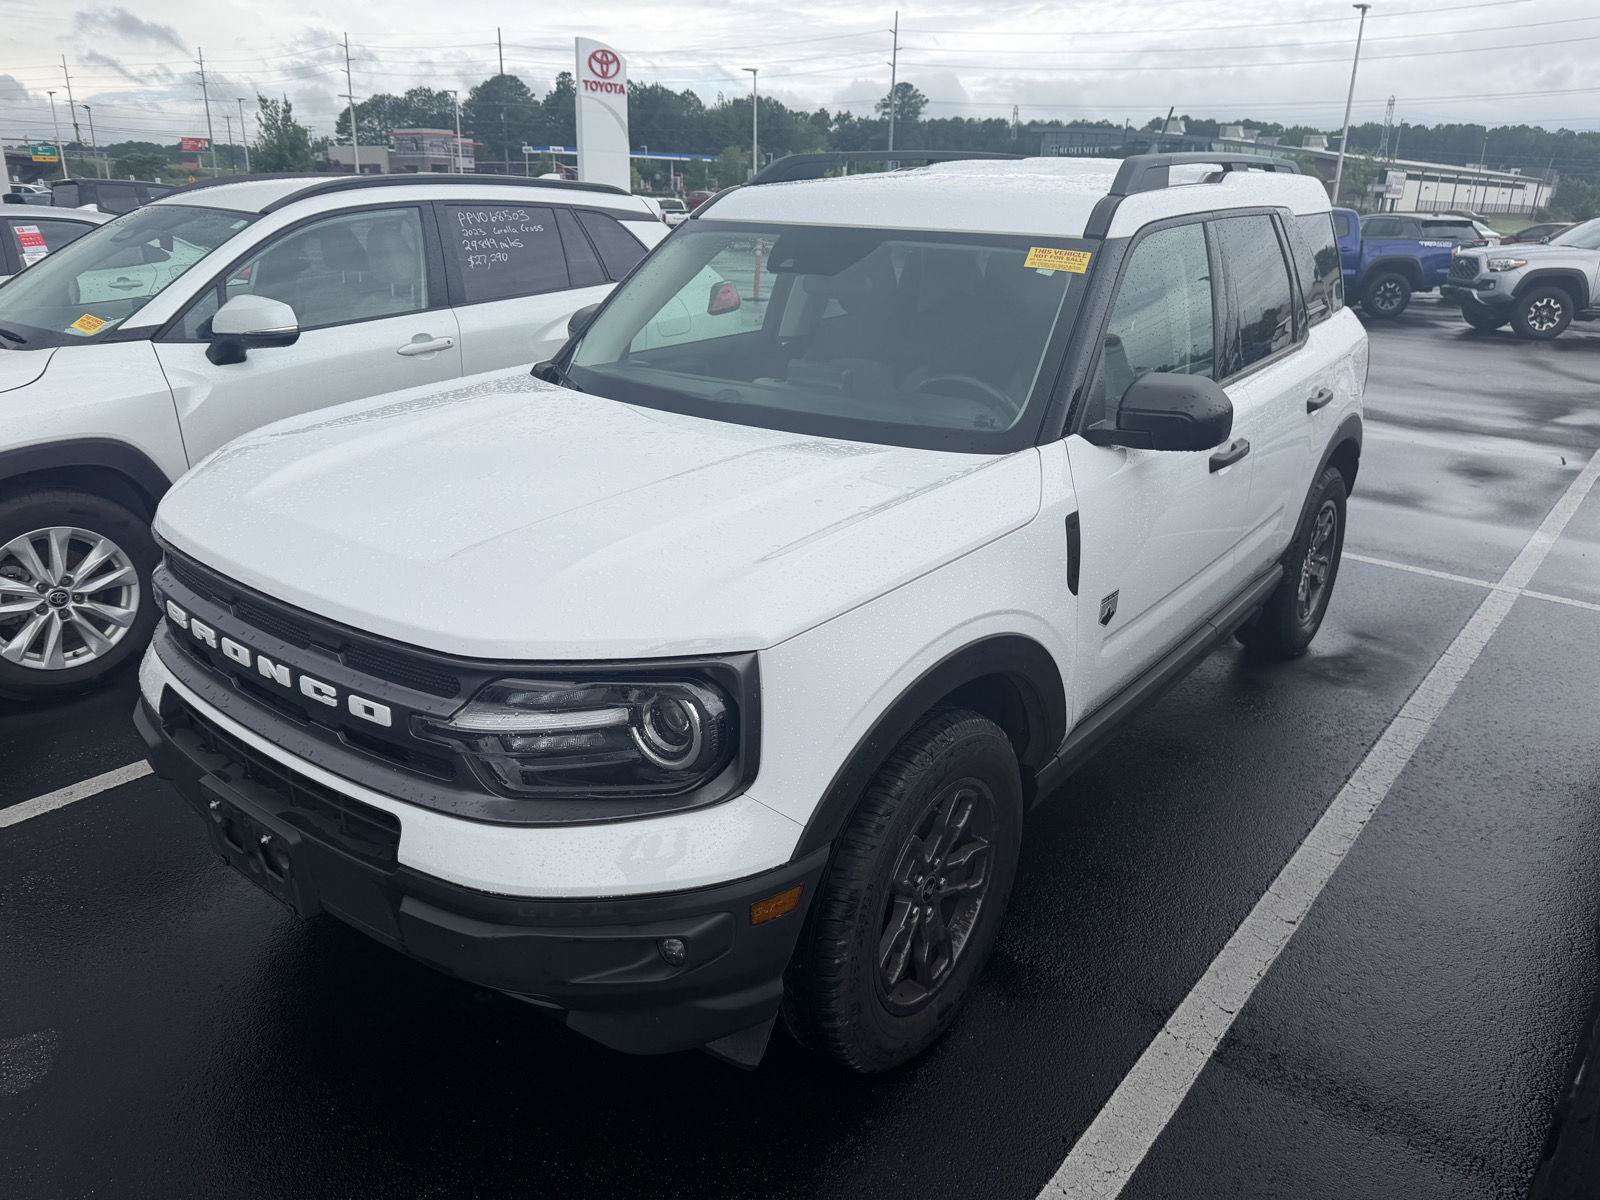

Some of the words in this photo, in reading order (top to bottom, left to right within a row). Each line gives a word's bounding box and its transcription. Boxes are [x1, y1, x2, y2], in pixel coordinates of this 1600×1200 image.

[582, 79, 626, 95] TOYOTA
[461, 228, 487, 237] 2023
[467, 252, 508, 270] $27,290
[1054, 250, 1087, 259] VEHICLE
[166, 599, 392, 727] BRONCO
